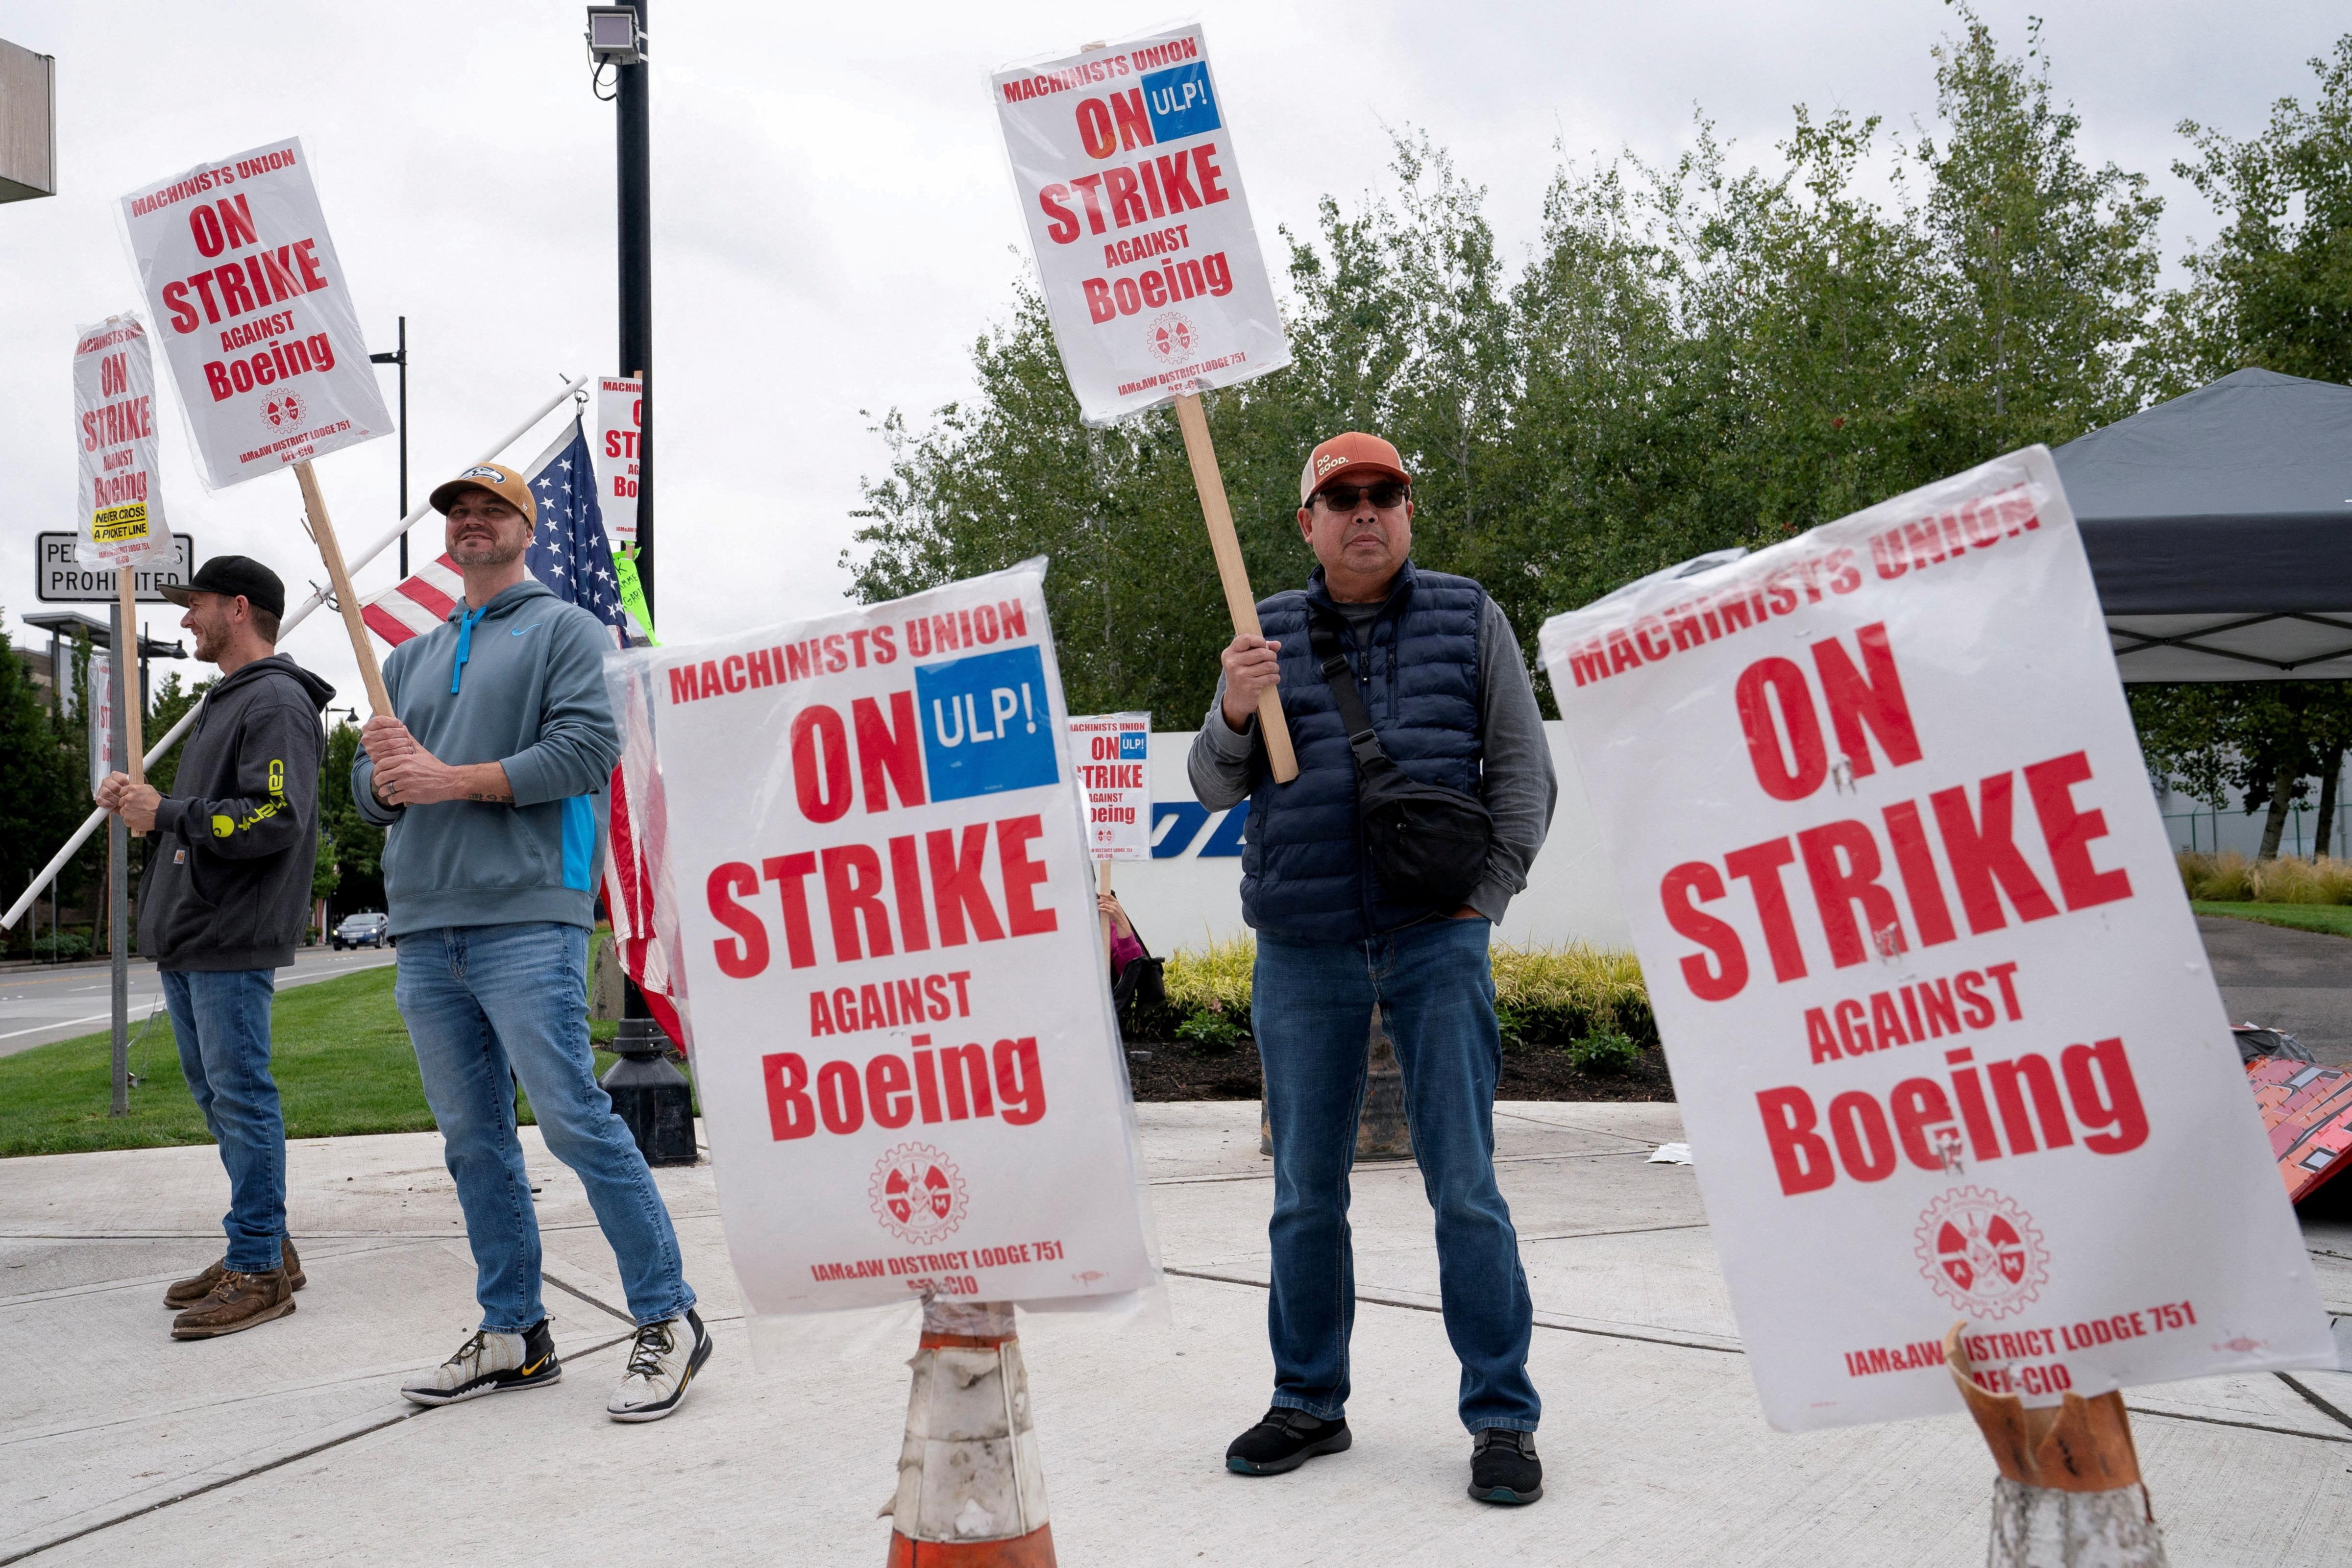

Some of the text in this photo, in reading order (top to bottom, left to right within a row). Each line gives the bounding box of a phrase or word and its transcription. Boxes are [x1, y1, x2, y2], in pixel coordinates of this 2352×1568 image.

[1004, 37, 1197, 102] MACHINISTS UNION
[1076, 88, 1153, 159] ON
[1152, 80, 1207, 115] ULP!
[132, 149, 295, 216] MACHINISTS UNION
[1040, 144, 1228, 244] STRIKE
[190, 194, 257, 257] ON
[1105, 225, 1188, 268] AGAINST
[163, 239, 327, 333] STRIKE
[1083, 252, 1233, 323] Boeing
[76, 329, 123, 356] MACHINISTS
[221, 311, 294, 352] AGAINST
[102, 353, 126, 397] ON
[204, 333, 334, 401] Boeing
[603, 381, 642, 392] MACHIN
[1119, 353, 1246, 394] IAM&AW DISTRICT LODGE 751
[83, 396, 151, 451] STRIKE
[241, 420, 350, 462] IAM&AW DISTRICT LODGE 751
[103, 449, 133, 470] AGAINST
[281, 445, 314, 462] AFL-CIO
[1317, 454, 1330, 468] DO
[1319, 457, 1349, 476] GOOD.
[95, 471, 147, 508] Boeing
[96, 506, 145, 523] NEVER CROSS
[95, 523, 147, 539] A PICKET LINE
[52, 572, 179, 590] PROHIITED
[1568, 483, 2042, 687] MACHINISTS UNION
[669, 600, 1026, 704] MACHINISTS UNION
[933, 683, 1035, 747] ULP!
[1737, 622, 1922, 801] ON
[792, 691, 926, 823] ON
[1092, 737, 1119, 760] ON
[1123, 739, 1143, 749] ULP!
[1091, 804, 1135, 824] oeing
[707, 815, 1057, 978] STRIKE
[1661, 751, 2132, 1001] STRIKE
[810, 971, 970, 1037] AGAINST
[1805, 962, 2022, 1064] AGAINST
[762, 1034, 1046, 1141] Boeing
[1756, 1038, 2149, 1196] Boeing
[811, 1241, 1063, 1280] IAM&AW DISTRICT LODGE 751
[1846, 1301, 2196, 1376] IAM&AW ISTRICT LODGE 751
